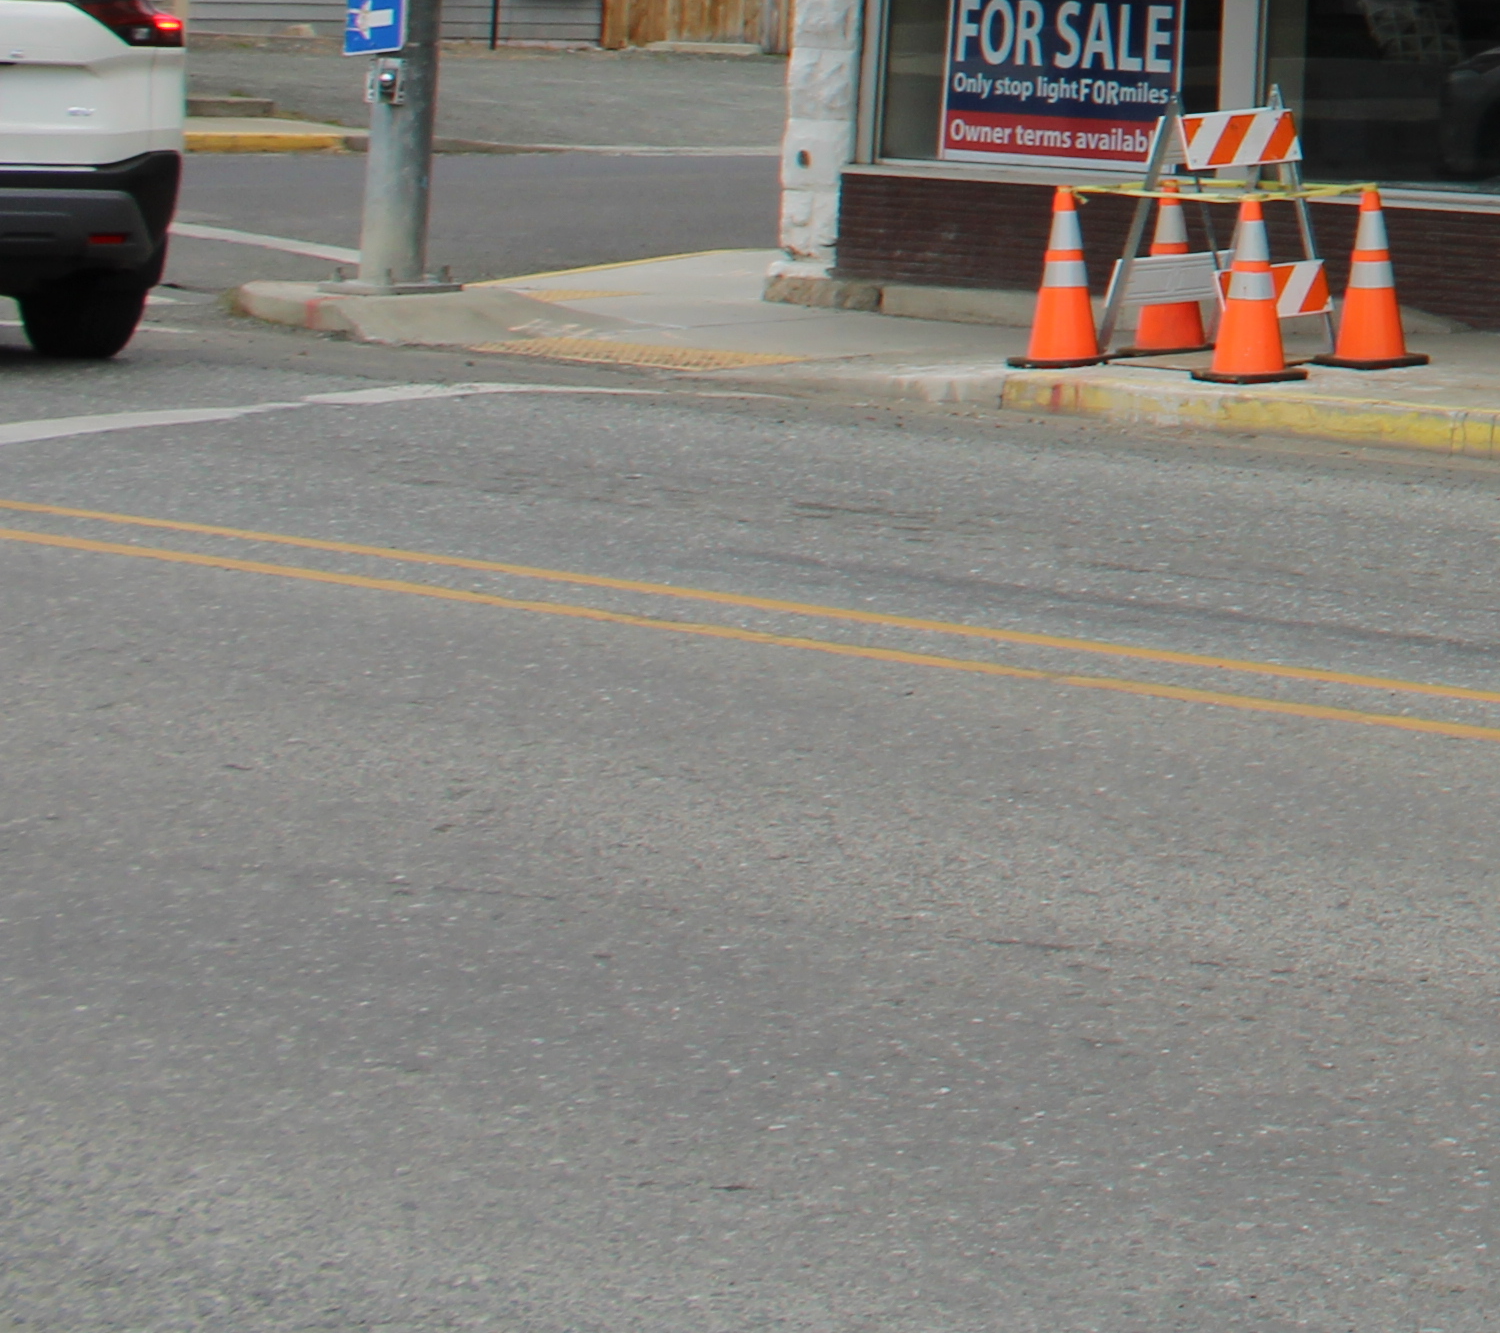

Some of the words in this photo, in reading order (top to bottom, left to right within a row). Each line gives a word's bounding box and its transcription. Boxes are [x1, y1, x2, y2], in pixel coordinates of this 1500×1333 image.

[1053, 0, 1174, 73] SALE
[953, 72, 992, 100] Only
[994, 76, 1033, 101] stop
[1036, 74, 1079, 104] light
[1079, 79, 1119, 106] FOR
[951, 118, 1012, 144] Owner
[1016, 125, 1072, 148] terms
[1075, 128, 1155, 153] availab
